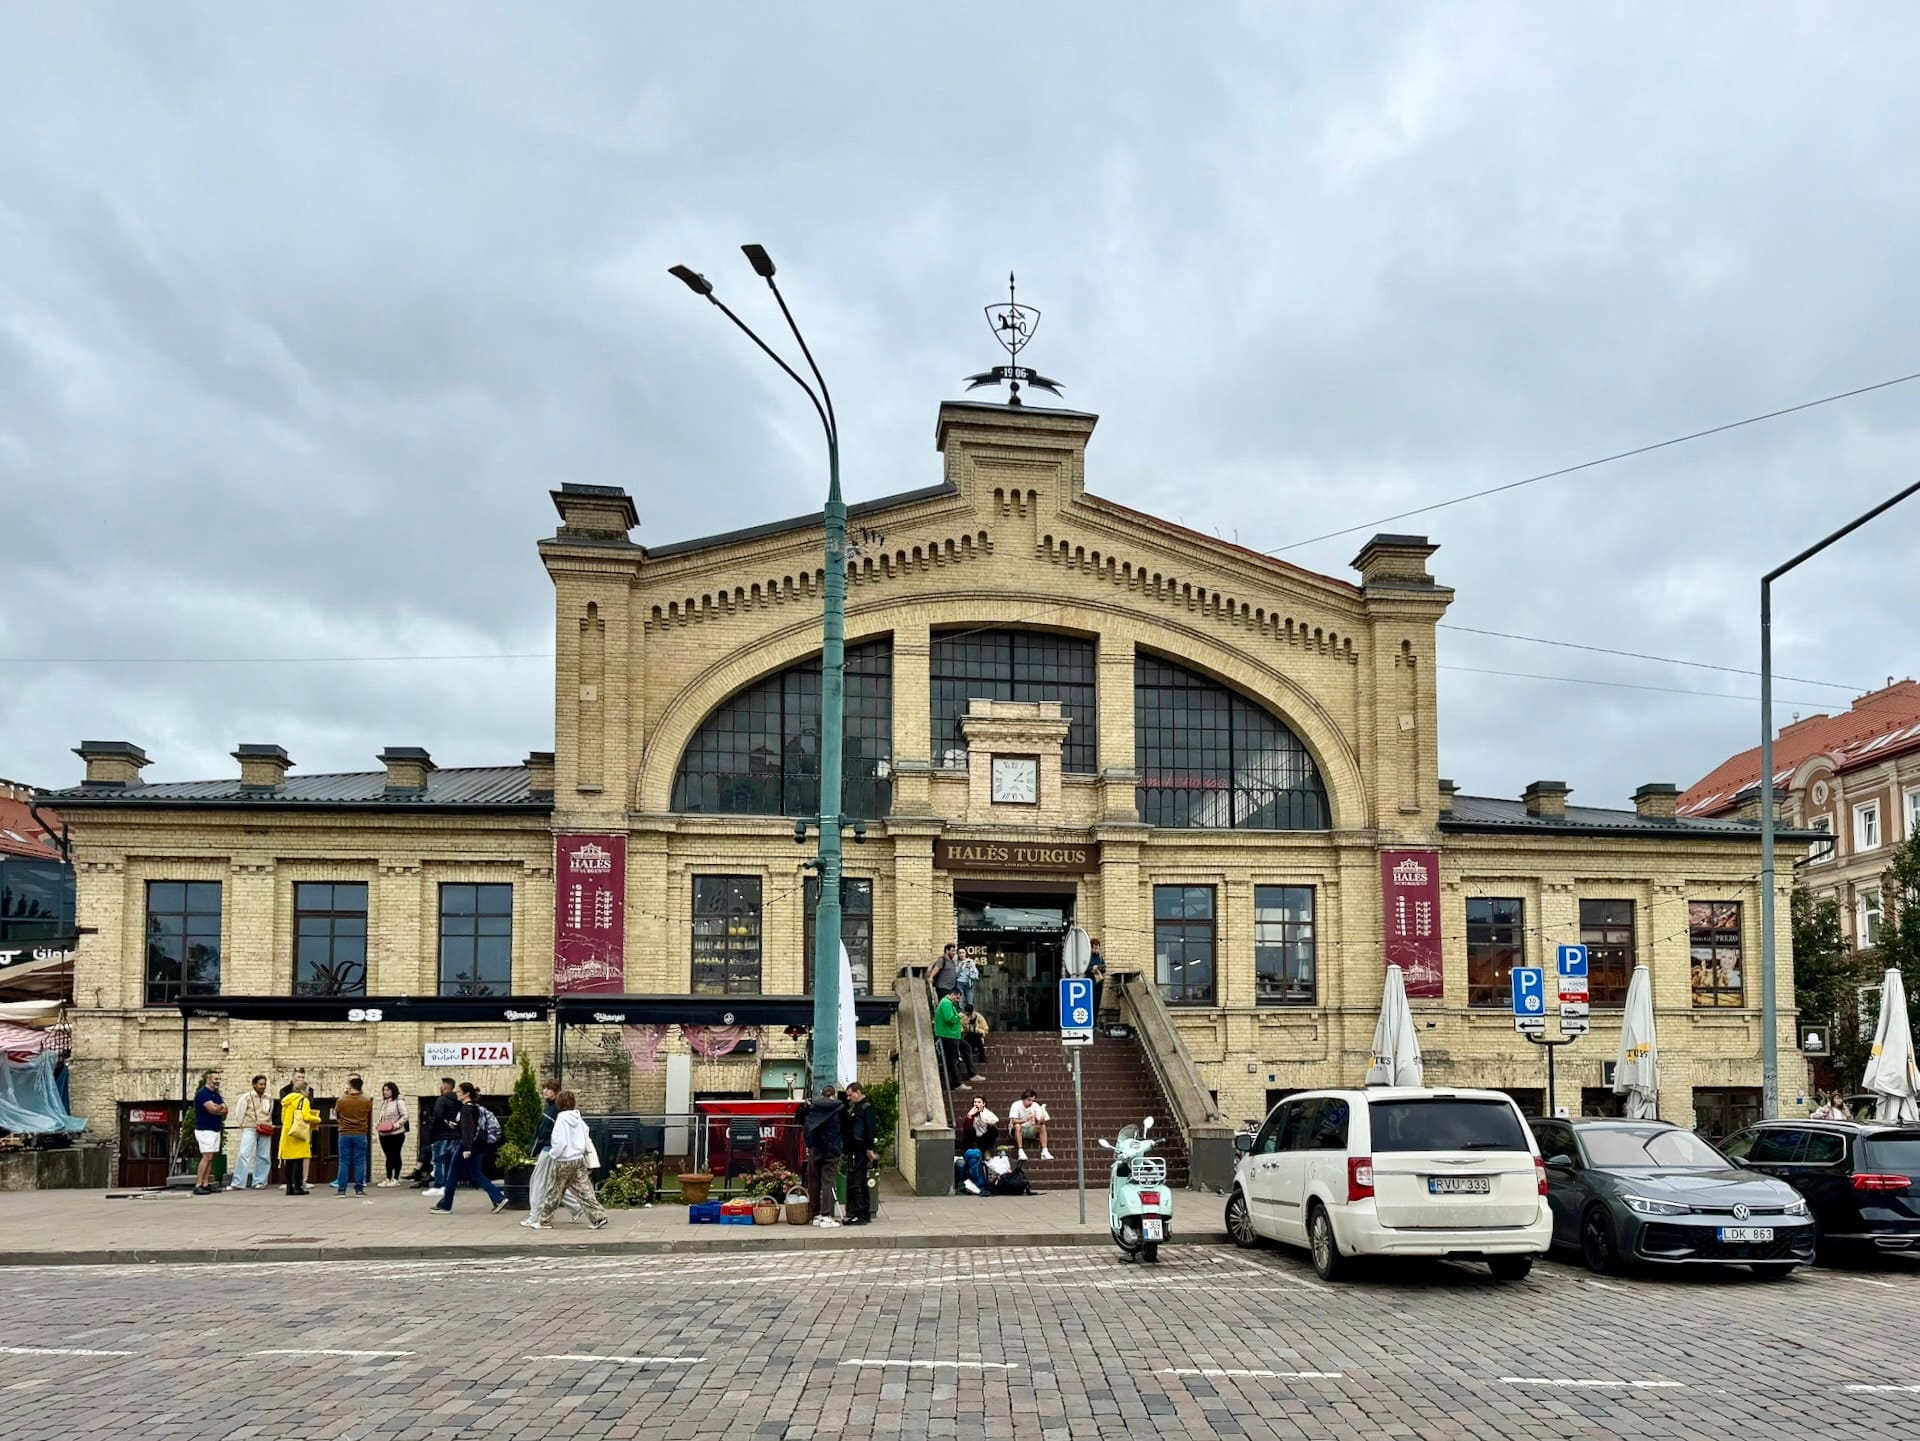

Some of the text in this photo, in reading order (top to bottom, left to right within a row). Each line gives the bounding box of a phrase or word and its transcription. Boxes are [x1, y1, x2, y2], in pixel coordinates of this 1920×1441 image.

[947, 845, 1086, 864] HALĖS TURGUS
[1565, 948, 1582, 973] P
[1521, 971, 1537, 994] P
[1070, 982, 1086, 1007] P
[348, 1009, 383, 1022] 98
[461, 1047, 509, 1060] PIZZA
[1437, 1180, 1487, 1190] RVU 333
[1724, 1229, 1772, 1239] LDK 863
